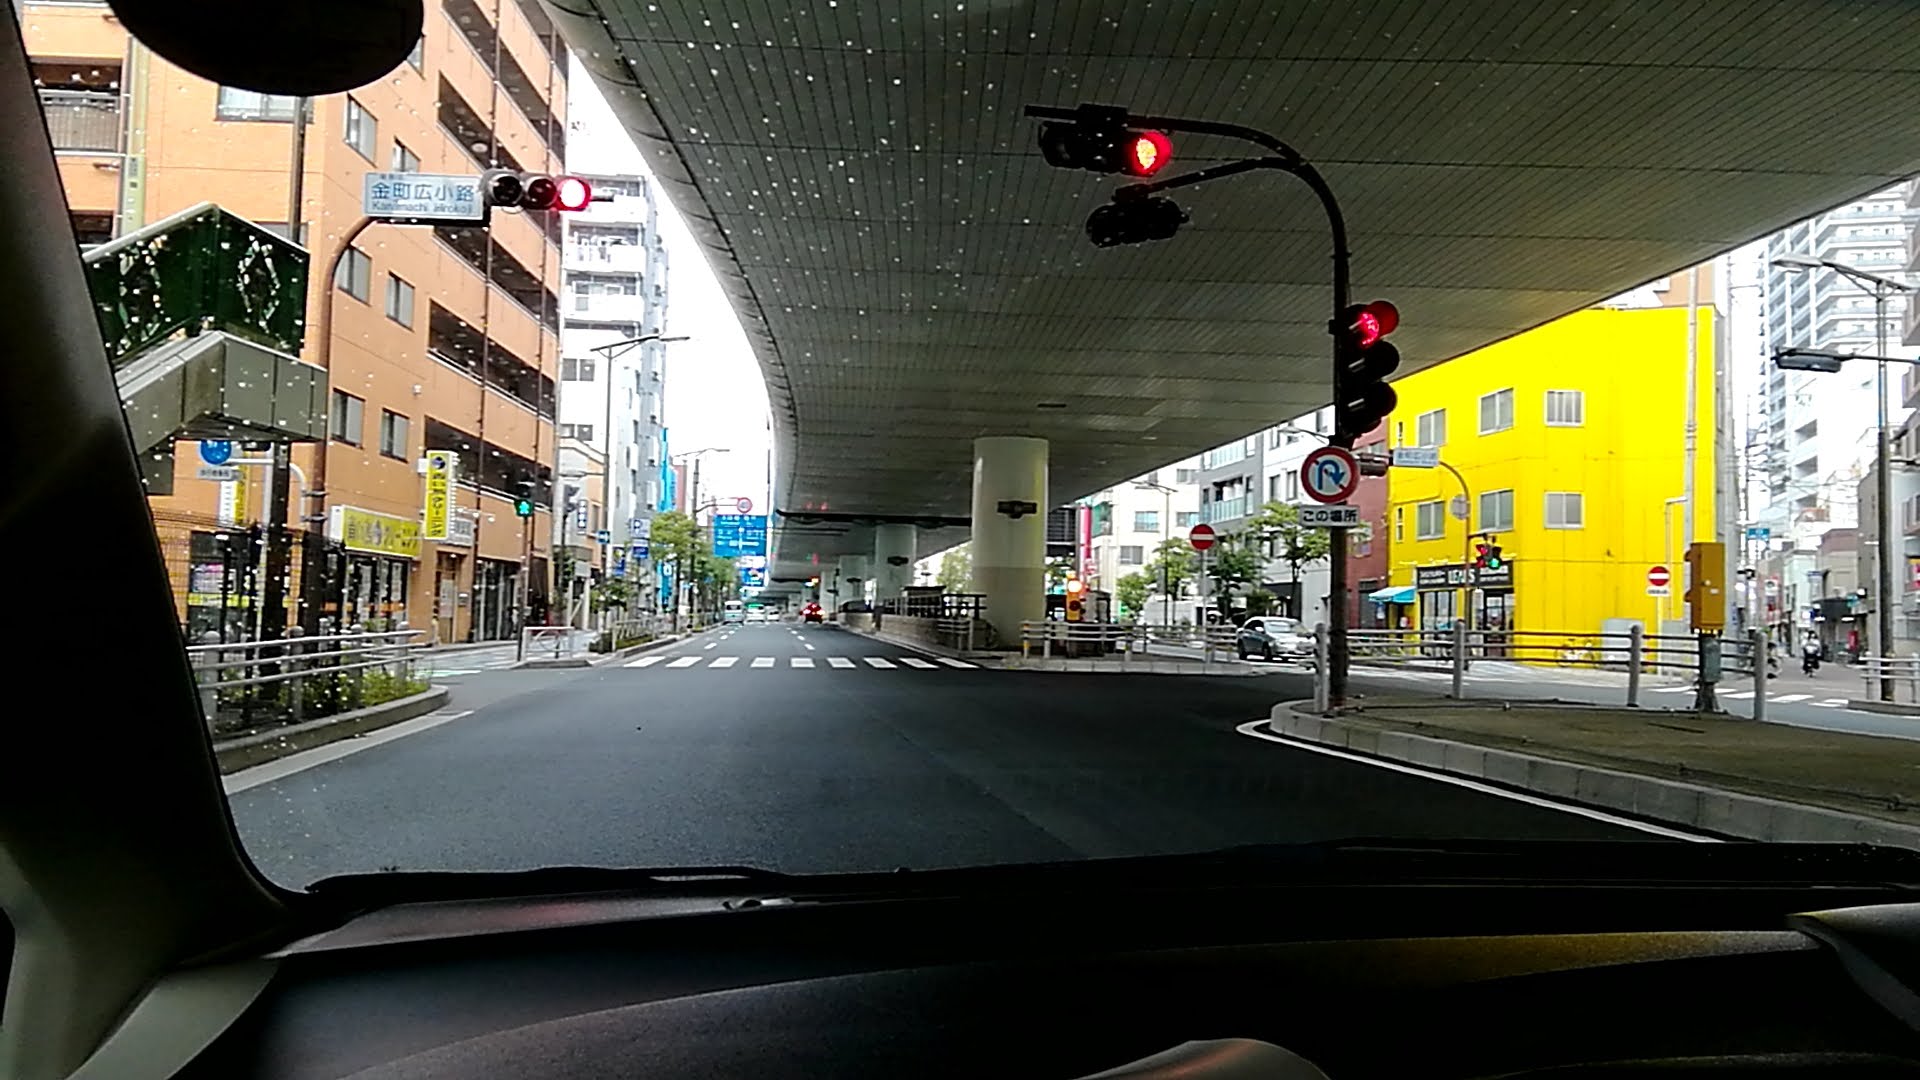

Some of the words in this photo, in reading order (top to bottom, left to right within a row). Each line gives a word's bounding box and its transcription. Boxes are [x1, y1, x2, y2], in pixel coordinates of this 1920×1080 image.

[371, 182, 475, 202] 金町広小路
[1303, 509, 1357, 523] この場所
